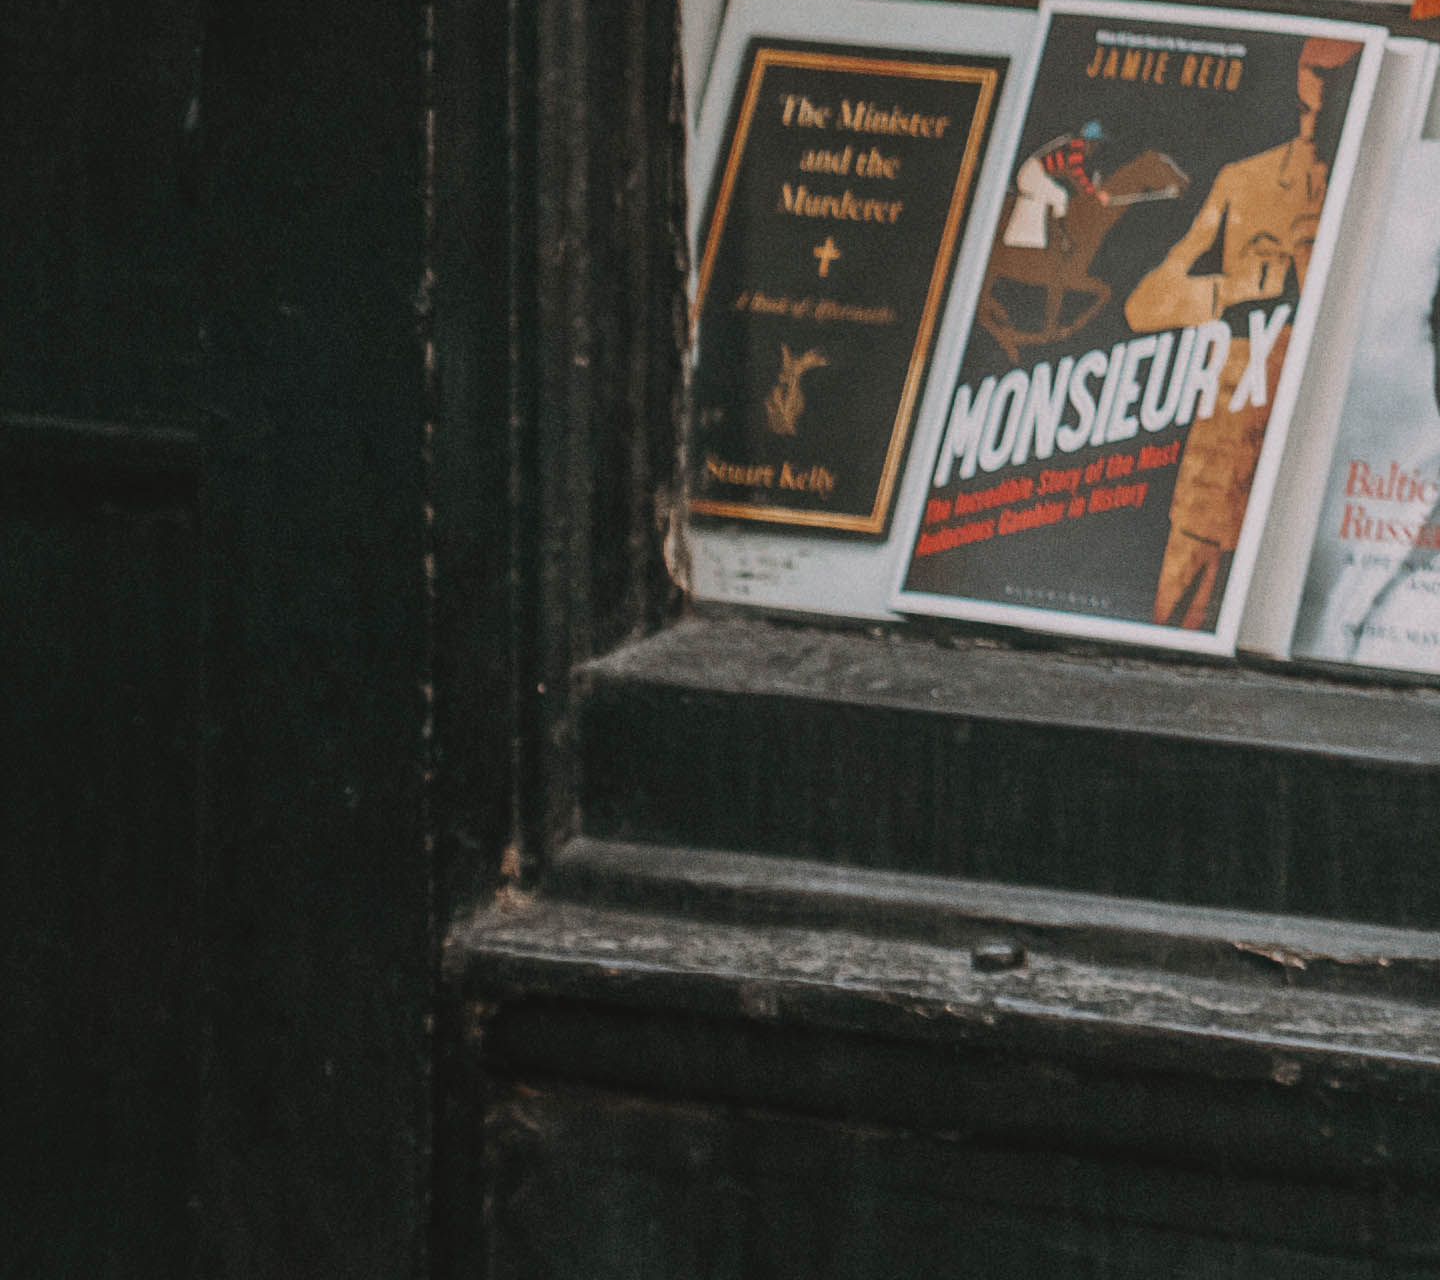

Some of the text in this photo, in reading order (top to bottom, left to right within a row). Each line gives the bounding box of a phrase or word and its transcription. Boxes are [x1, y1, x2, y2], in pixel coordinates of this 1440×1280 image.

[1085, 45, 1244, 92] JAMIE REID
[780, 93, 950, 139] The Minister
[800, 144, 901, 179] and the
[777, 182, 903, 224] Murderer
[935, 302, 1293, 488] MONSIEUR X
[1344, 458, 1438, 503] Baltic
